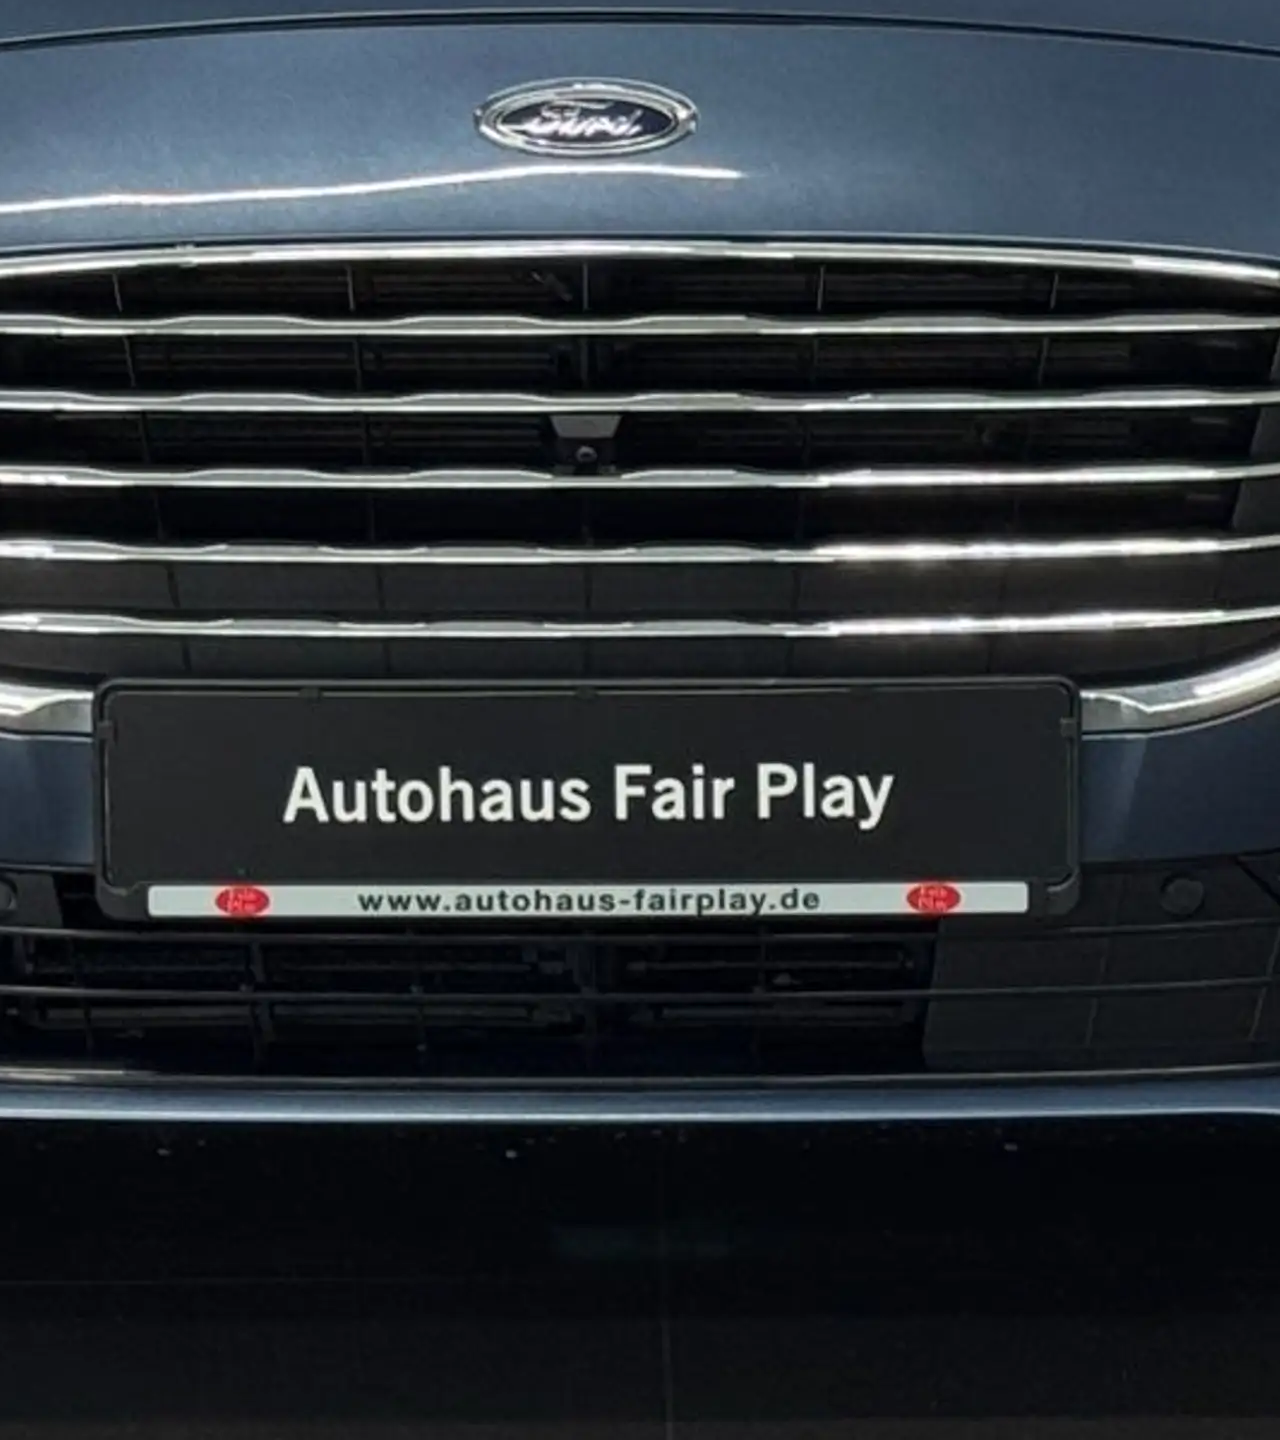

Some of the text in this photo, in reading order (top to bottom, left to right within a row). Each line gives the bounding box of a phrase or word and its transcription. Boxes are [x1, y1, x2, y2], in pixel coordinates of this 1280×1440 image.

[283, 762, 894, 830] Autohaus Fair Play
[357, 886, 821, 915] www.autohaus-fairplay.de
